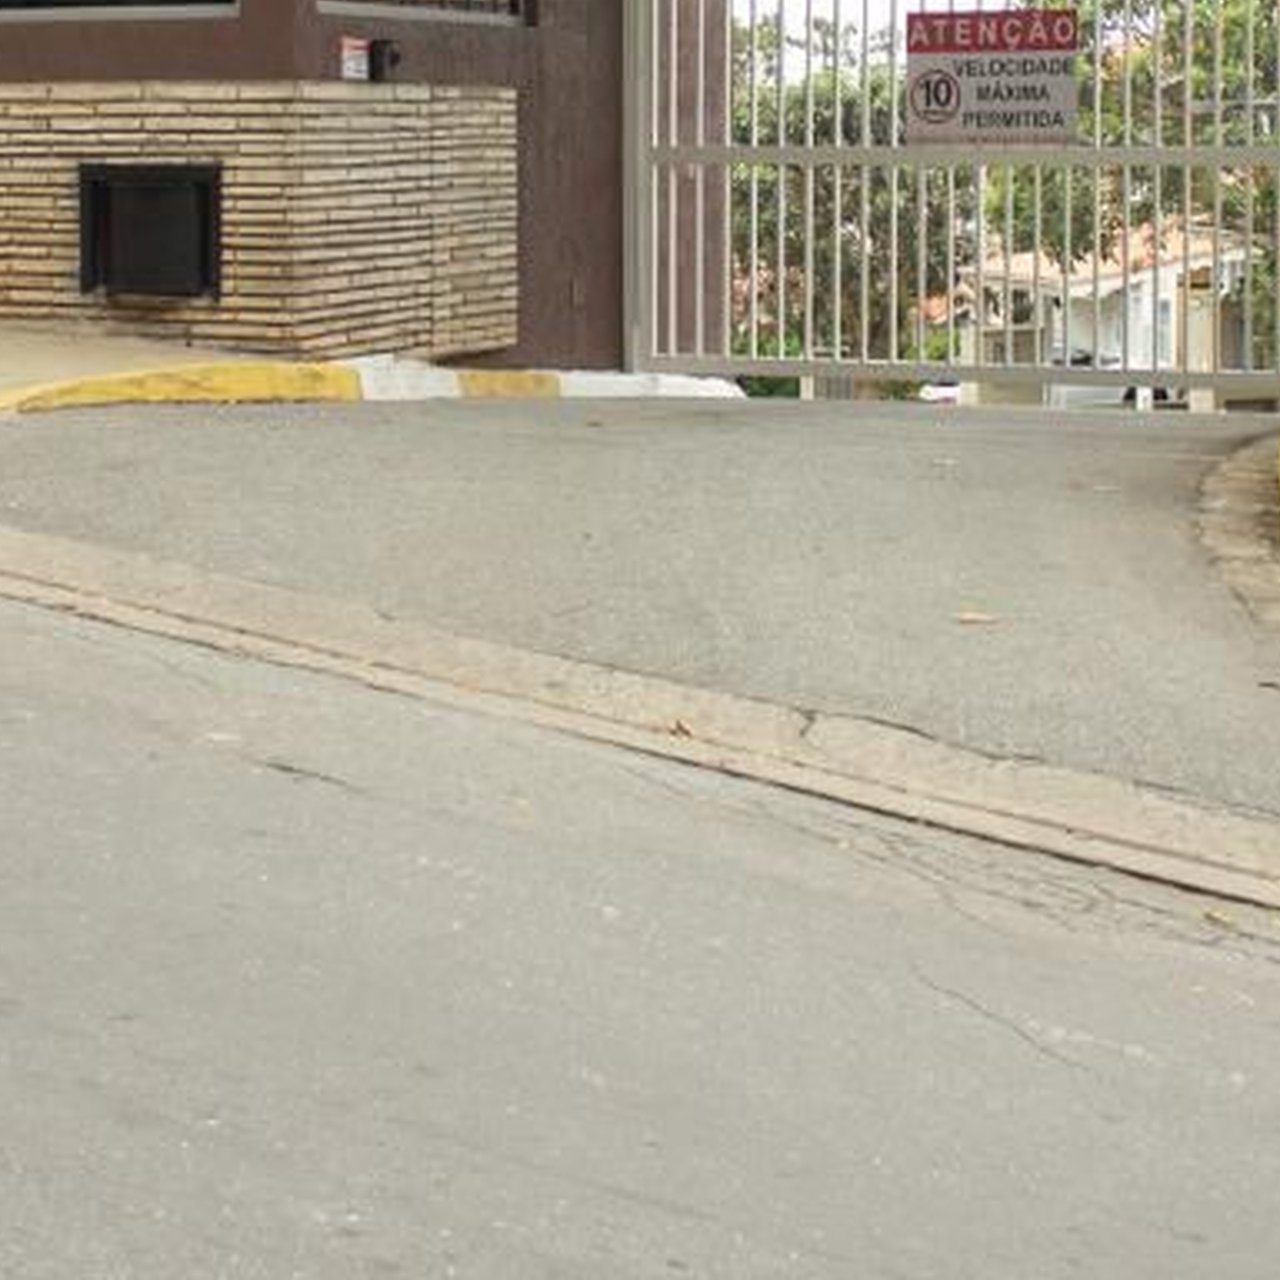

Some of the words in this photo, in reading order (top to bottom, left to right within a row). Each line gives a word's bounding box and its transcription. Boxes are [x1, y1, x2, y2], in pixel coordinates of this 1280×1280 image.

[909, 14, 1075, 49] ATENÇÃO
[953, 56, 1075, 78] VELOCIDADE
[920, 77, 953, 108] 10
[976, 81, 1051, 102] MÁXIMA
[962, 110, 1065, 129] PERMITIDA
